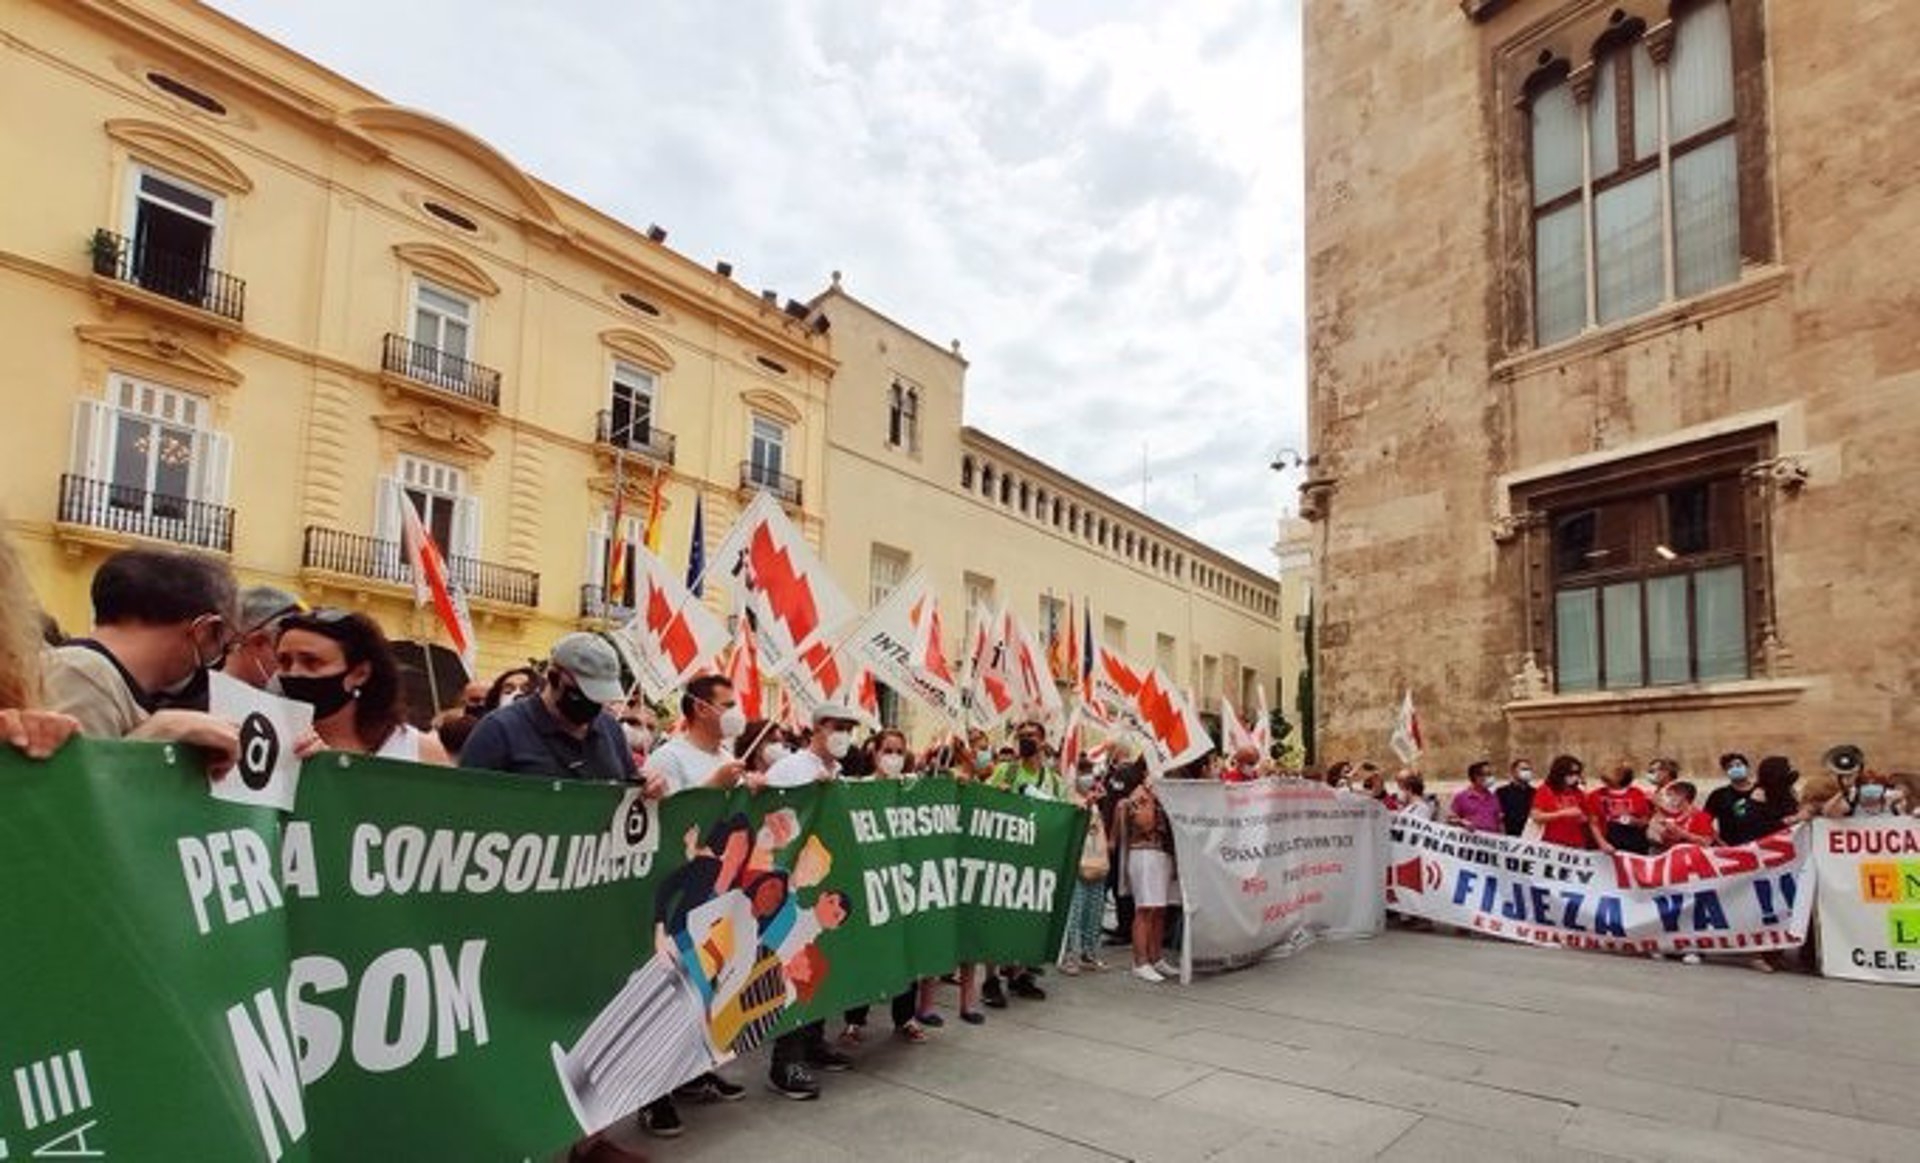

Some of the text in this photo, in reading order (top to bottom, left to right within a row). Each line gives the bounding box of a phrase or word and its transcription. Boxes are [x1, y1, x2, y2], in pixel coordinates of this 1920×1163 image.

[969, 808, 1036, 845] INTERÍ
[1611, 823, 1797, 888] IVASS
[177, 827, 284, 935] PER
[1452, 868, 1627, 937] FIJEZA
[1652, 889, 1730, 932] YA
